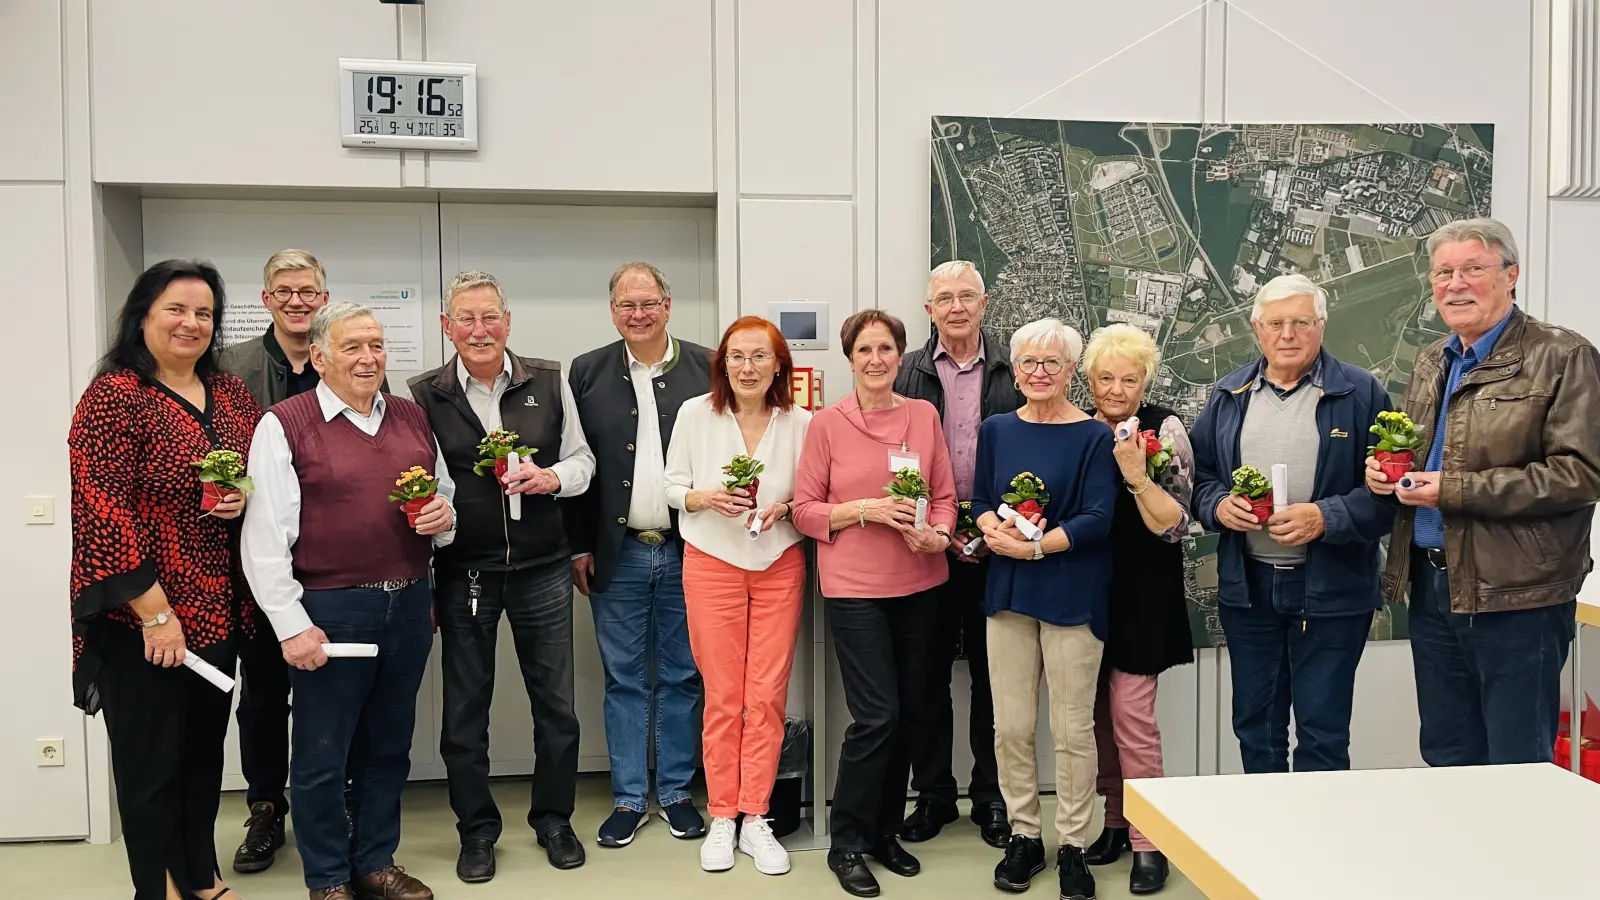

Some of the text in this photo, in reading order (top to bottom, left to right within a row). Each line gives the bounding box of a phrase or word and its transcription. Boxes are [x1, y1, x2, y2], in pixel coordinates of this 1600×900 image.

[367, 76, 463, 117] 19:16 52
[443, 123, 456, 137] 35
